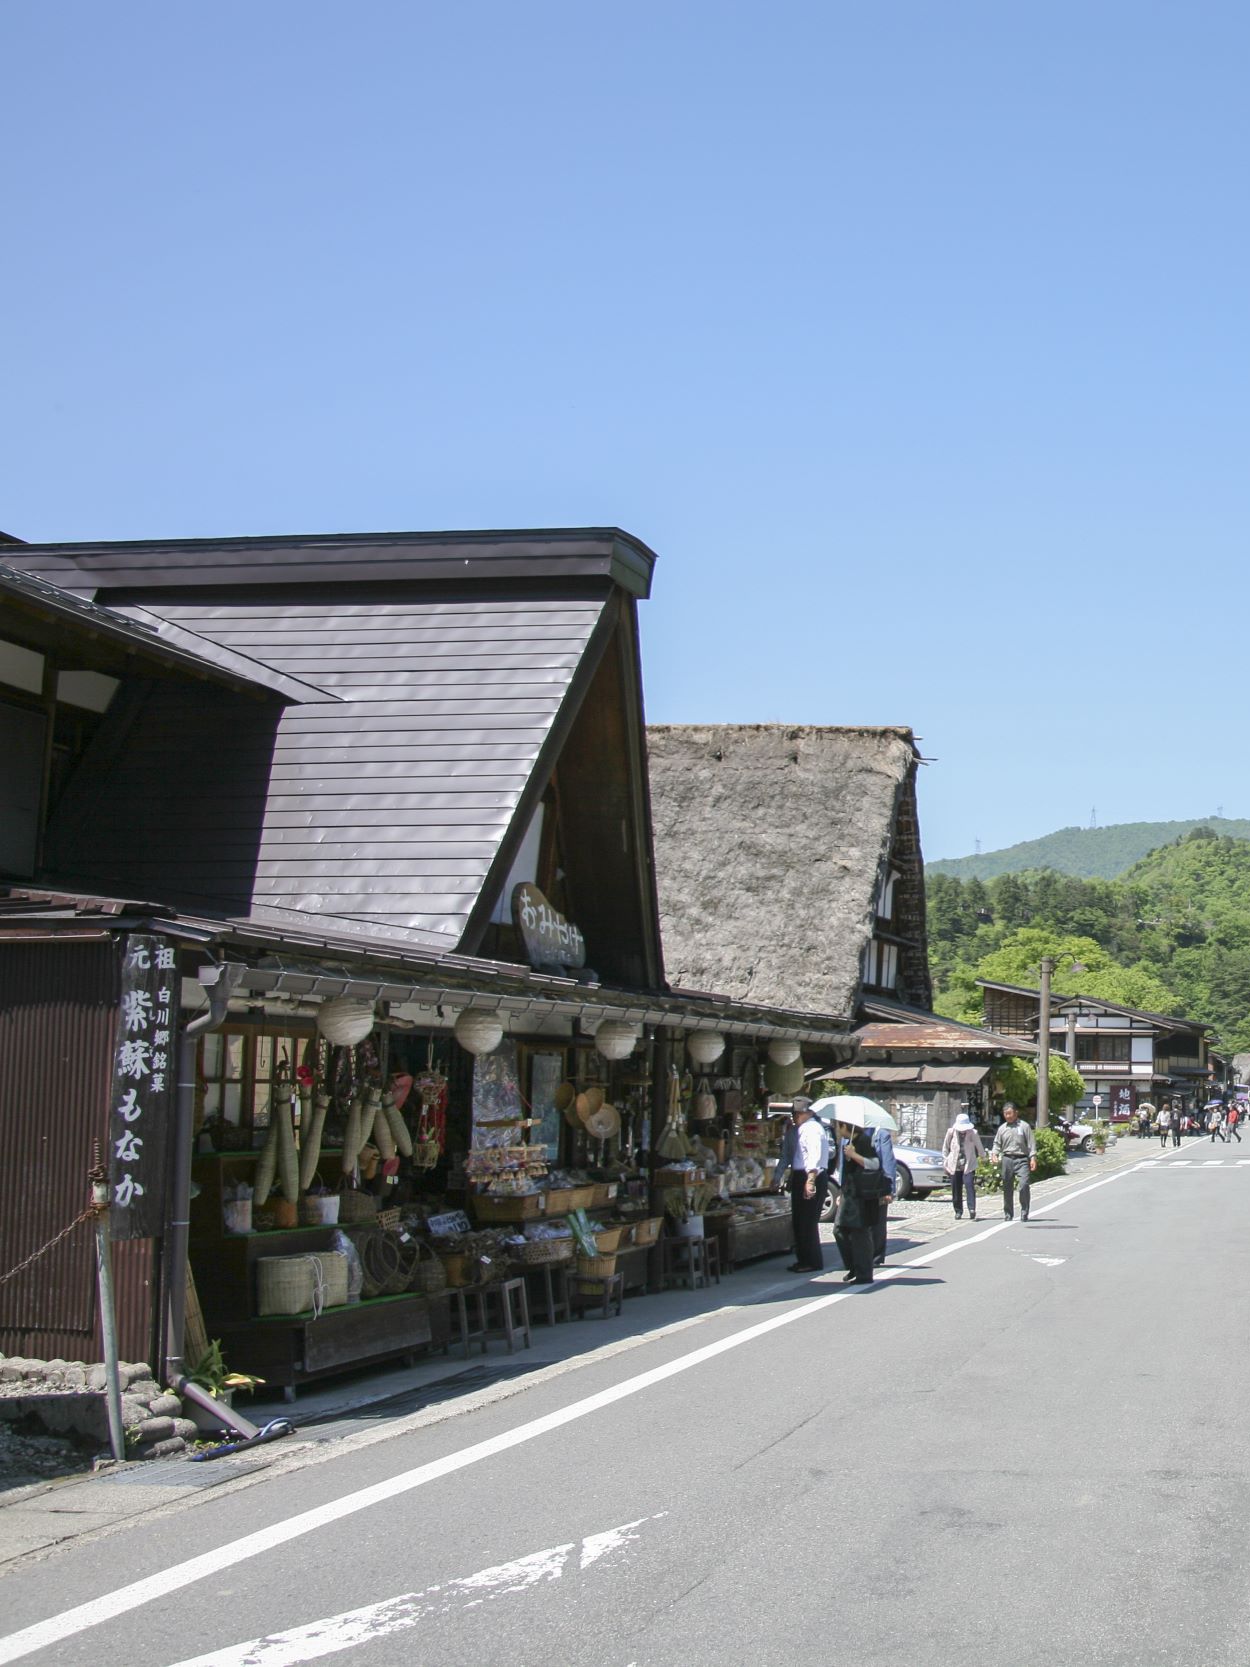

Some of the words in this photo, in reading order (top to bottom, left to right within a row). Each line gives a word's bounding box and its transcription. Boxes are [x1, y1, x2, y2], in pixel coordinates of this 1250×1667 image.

[129, 944, 176, 969] 元祖
[150, 986, 172, 1093] 白川郷銘菓
[115, 989, 153, 1207] 紫蘇もなか
[1118, 1088, 1131, 1116] 地酒
